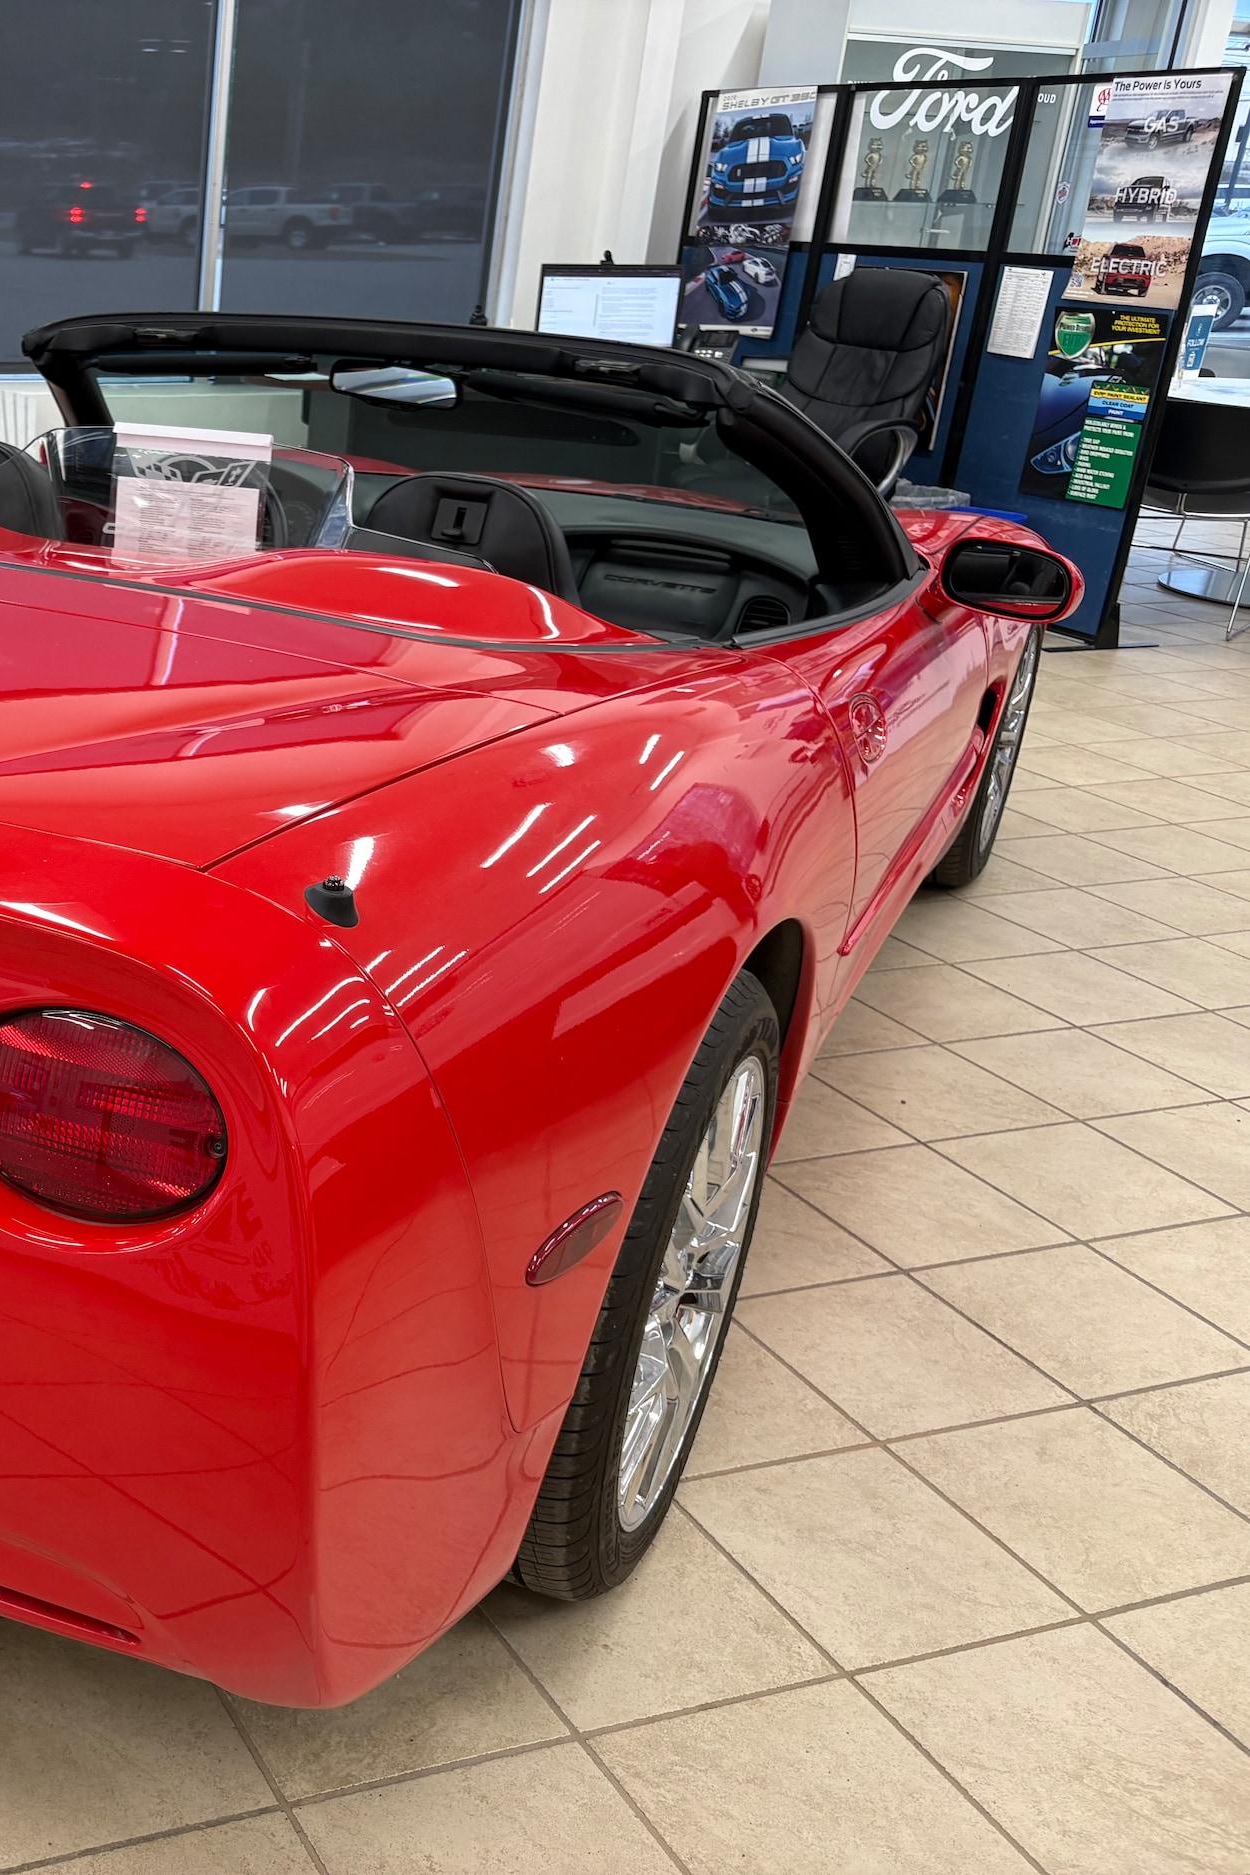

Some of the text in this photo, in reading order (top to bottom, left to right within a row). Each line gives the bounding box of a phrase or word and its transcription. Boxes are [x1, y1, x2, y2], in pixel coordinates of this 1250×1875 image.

[869, 48, 1020, 137] Ford
[1114, 78, 1202, 92] The Power Is Yours
[722, 97, 770, 110] SHELBY
[1037, 93, 1057, 104] OUD
[1144, 116, 1180, 133] GAS
[1114, 188, 1178, 204] HYBRID
[1090, 257, 1168, 277] ELECTRIC
[1114, 319, 1148, 328] PROTECTION
[604, 573, 717, 595] CORVETTE
